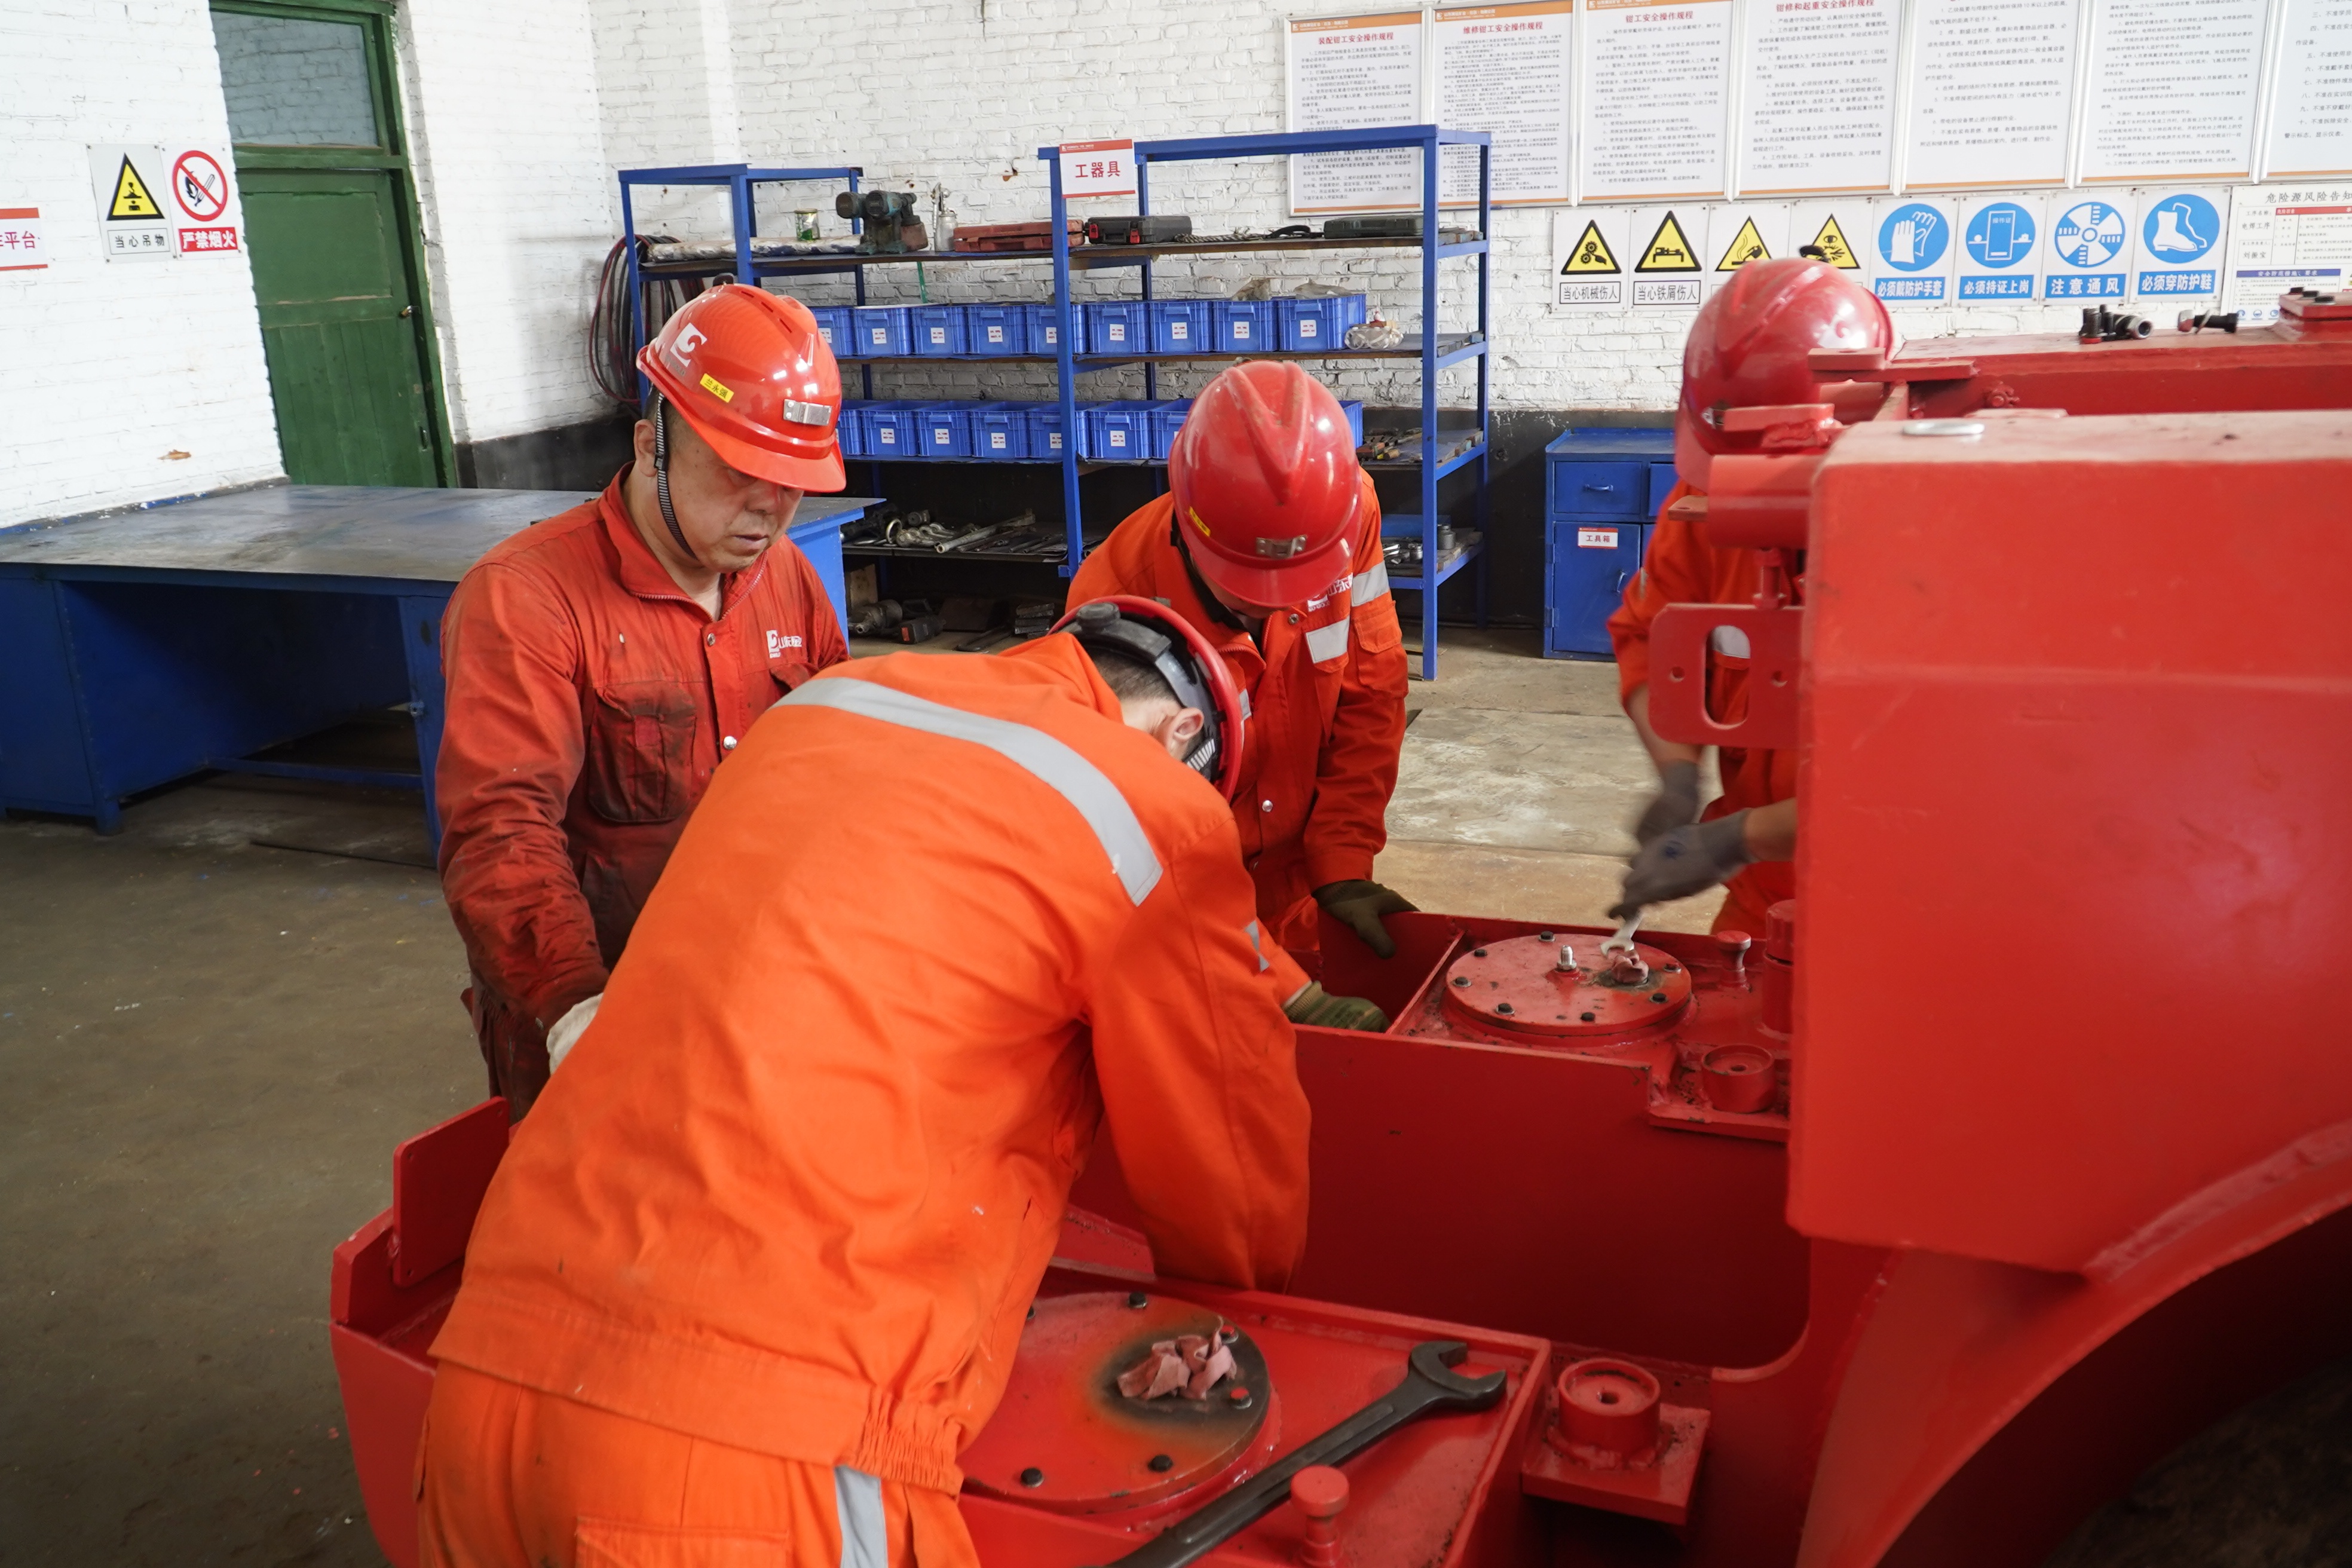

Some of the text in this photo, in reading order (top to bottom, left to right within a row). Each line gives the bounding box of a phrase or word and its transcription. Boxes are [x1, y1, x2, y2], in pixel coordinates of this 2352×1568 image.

[1626, 11, 1693, 23] 钳工安全操作规程
[1463, 22, 1544, 35] 维修钳工安全操作规程
[1318, 32, 1394, 45] 装配钳工安全操作规程
[1075, 161, 1120, 178] 工器具
[2265, 191, 2352, 204] 危险源风险告知
[2242, 222, 2270, 230] 电焊工序
[0, 231, 36, 250] 平台
[115, 234, 166, 249] 当心吊物
[182, 231, 235, 249] 严禁烟火
[1877, 280, 1942, 297] 必须戴防护手套
[1964, 279, 2029, 295] 必须持证上岗
[2051, 277, 2120, 295] 注意通风
[2142, 273, 2212, 292] 必须穿防护鞋
[1563, 286, 1618, 301] 当心机械伤人
[1637, 284, 1696, 301] 当心铁屑伤人
